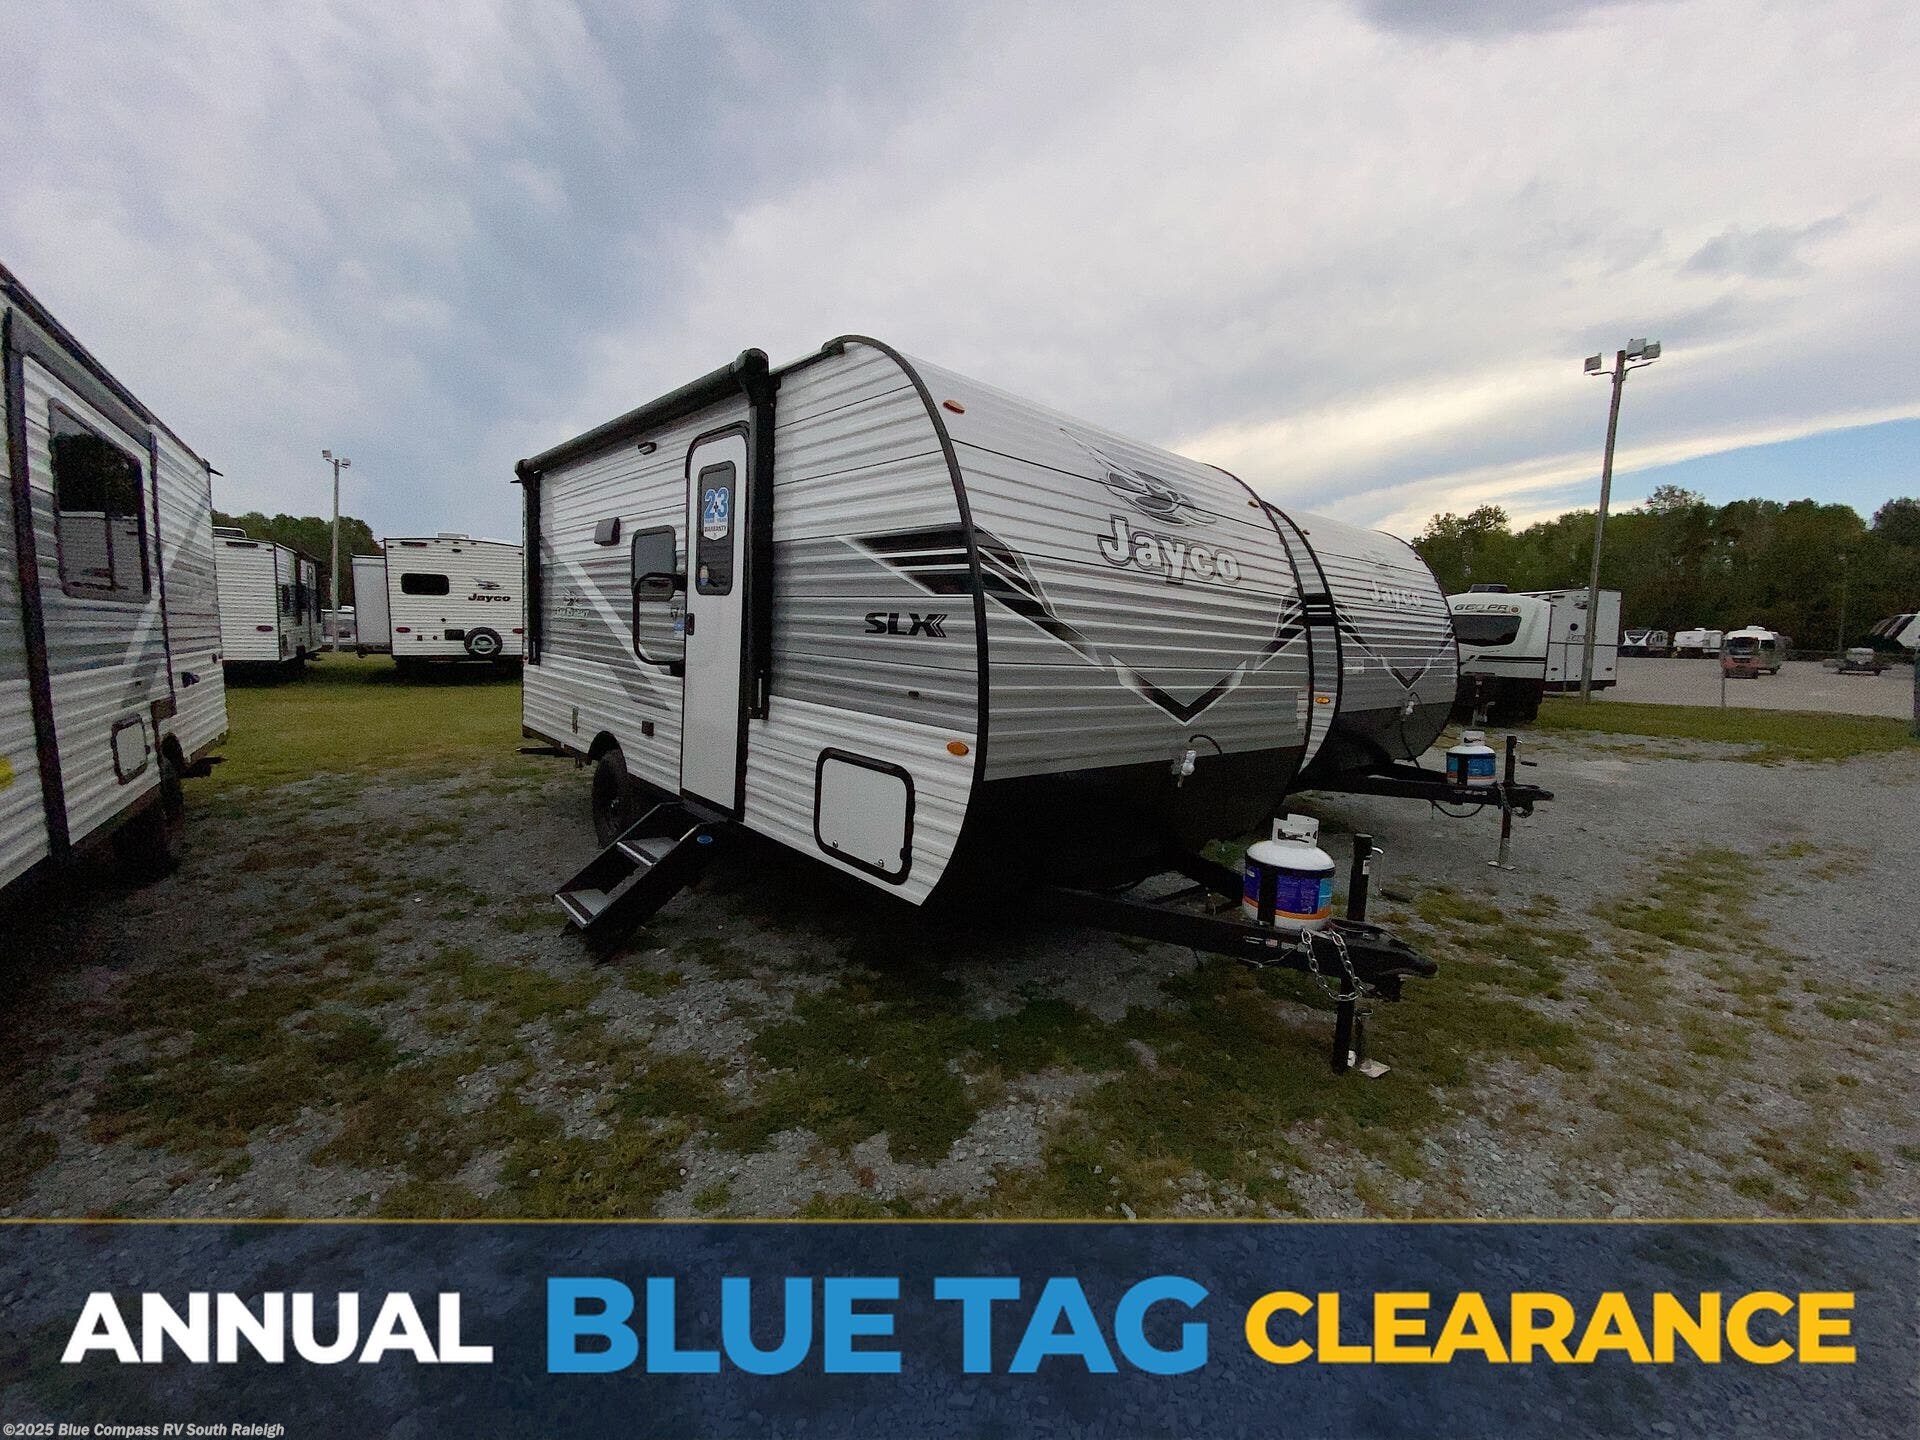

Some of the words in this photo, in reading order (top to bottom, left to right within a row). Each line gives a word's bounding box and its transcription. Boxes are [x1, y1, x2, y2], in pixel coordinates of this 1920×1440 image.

[1097, 514, 1241, 585] Jayco
[468, 593, 511, 603] Jayco
[865, 612, 947, 637] SLX
